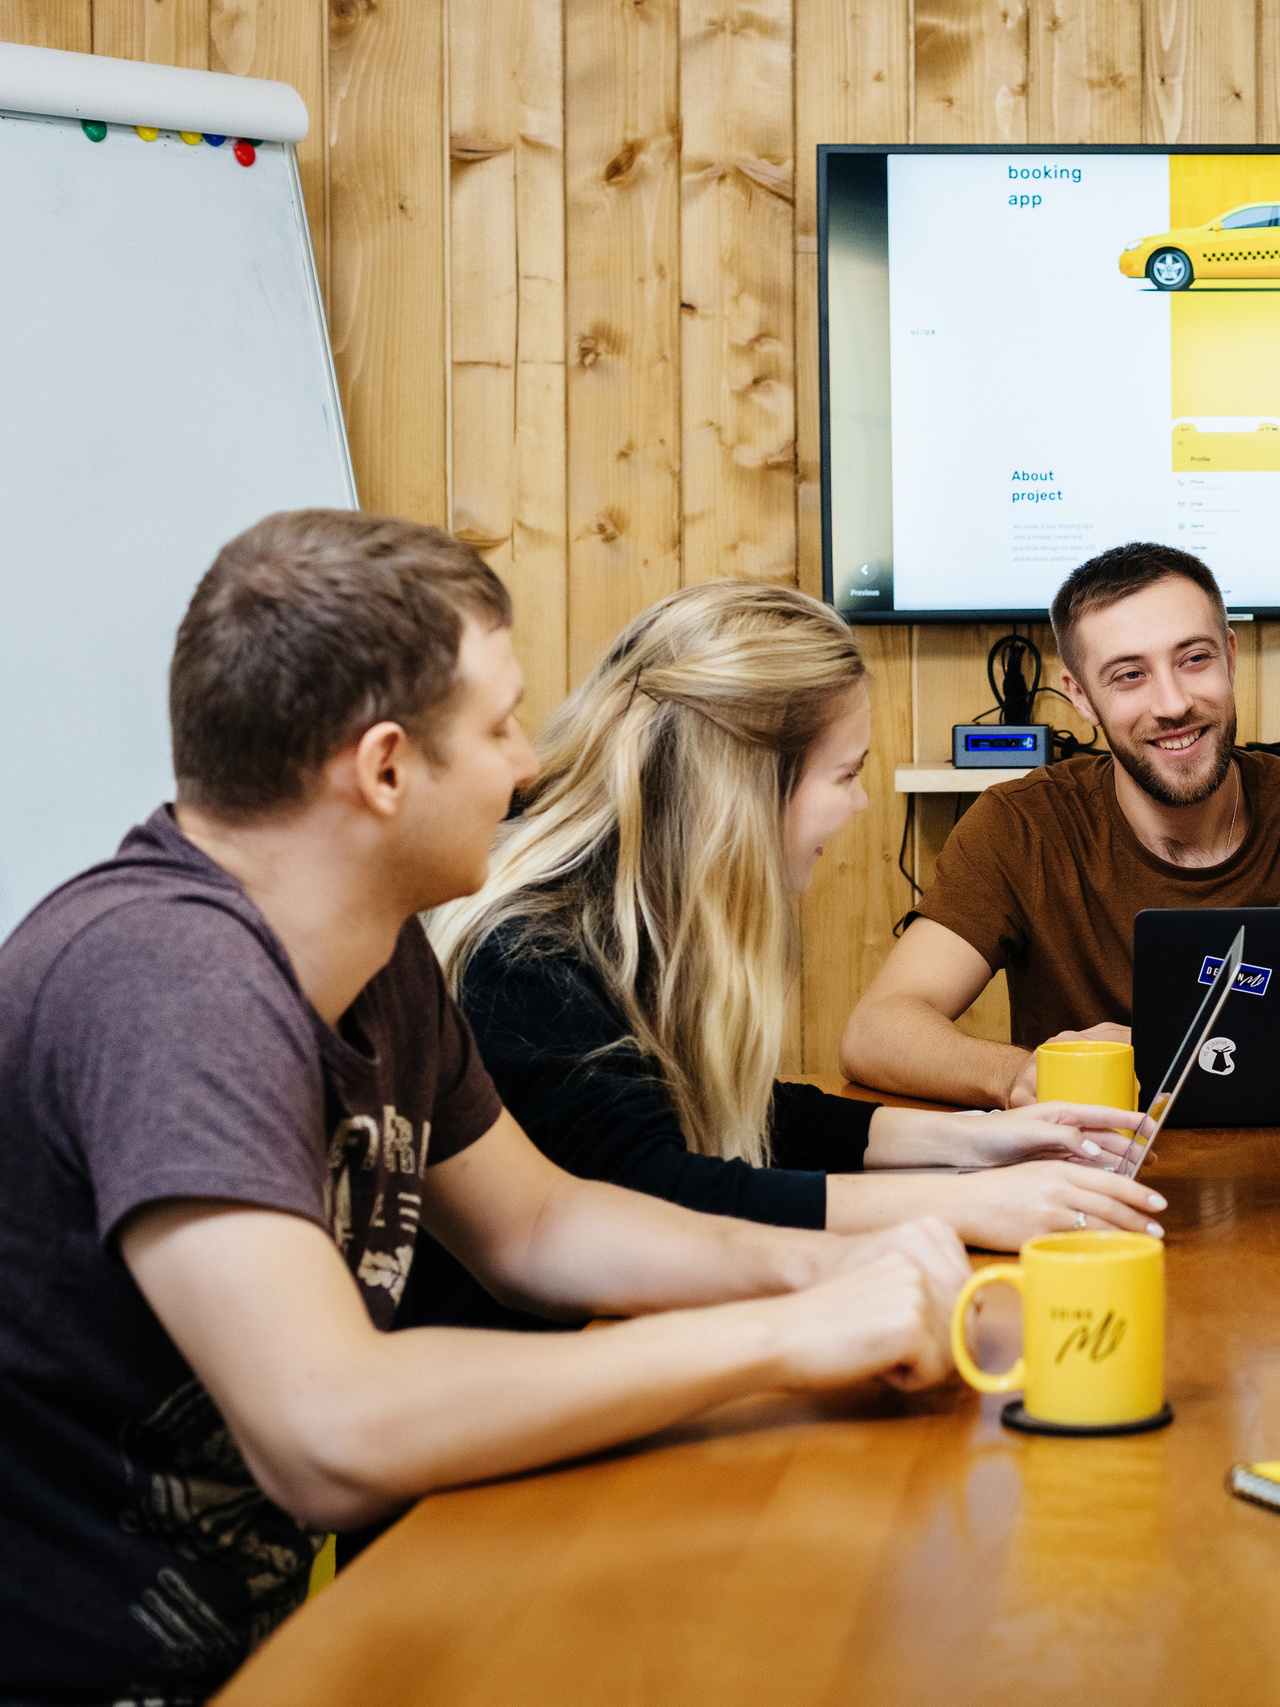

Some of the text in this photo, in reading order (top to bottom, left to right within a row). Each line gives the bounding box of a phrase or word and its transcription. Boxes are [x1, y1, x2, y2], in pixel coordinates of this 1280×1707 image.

[1008, 164, 1082, 183] booking
[1008, 194, 1042, 209] app
[1011, 470, 1055, 482] About
[1012, 490, 1063, 503] project
[850, 588, 880, 597] Previous
